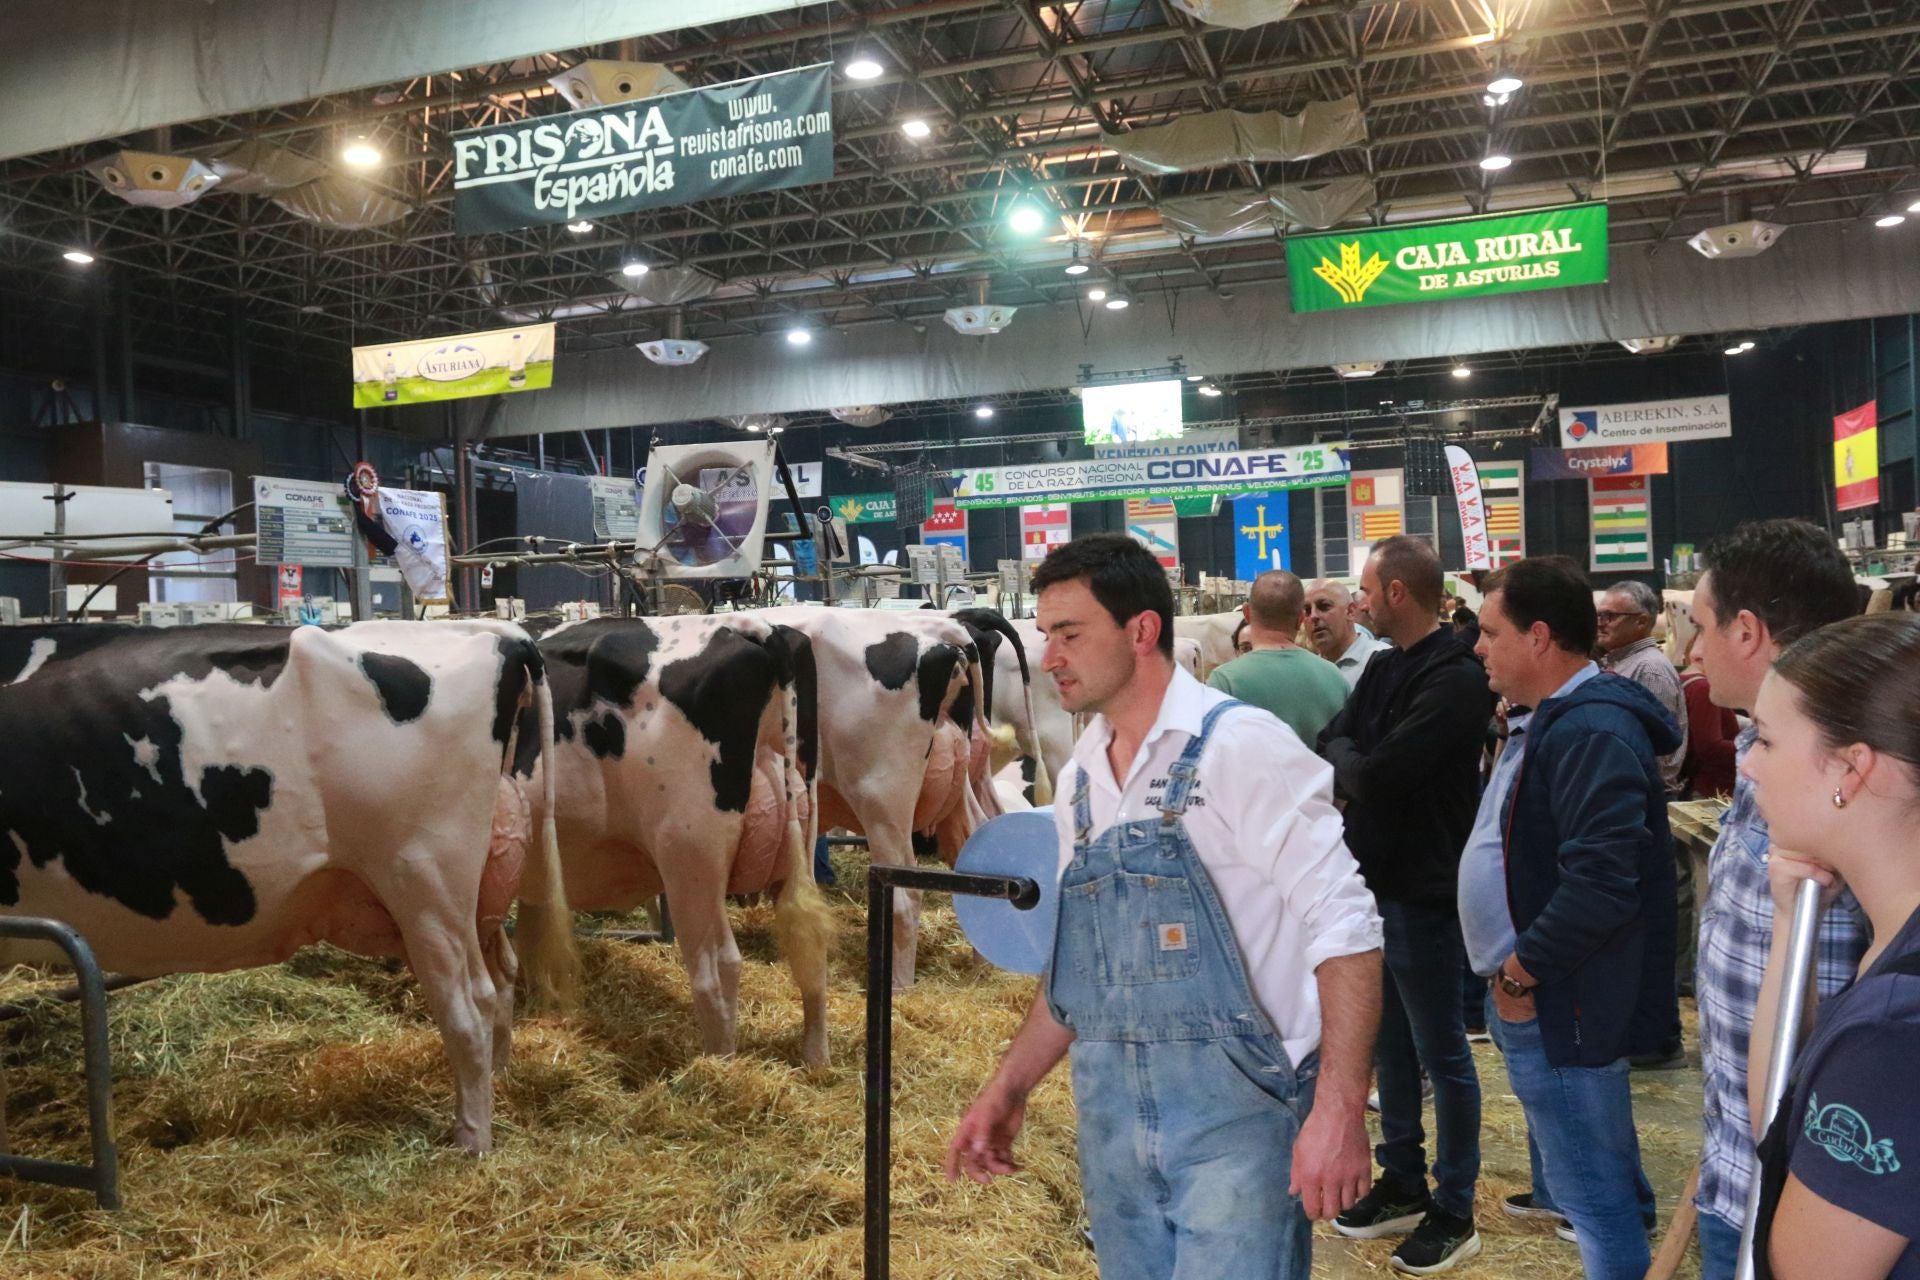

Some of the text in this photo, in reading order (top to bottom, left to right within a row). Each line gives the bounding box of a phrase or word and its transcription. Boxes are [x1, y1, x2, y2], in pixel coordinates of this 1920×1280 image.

[728, 93, 778, 121] www.
[454, 106, 674, 180] FRISONA
[680, 109, 831, 157] revistafrisona.com
[710, 145, 803, 180] conafe.com
[534, 151, 675, 219] Española
[1396, 228, 1582, 270] CAJA RURAL
[1419, 261, 1561, 291] DE ASTURIAS
[423, 358, 481, 375] ASTURIANA
[1602, 421, 1727, 438] Centro de Inseminación
[1005, 466, 1076, 481] CONCURSO
[1079, 462, 1144, 475] NACIONAL
[1147, 454, 1288, 480] CONAFE
[1568, 455, 1628, 471] Crystalyx
[1006, 494, 1044, 504] BENVIDOS
[1048, 490, 1096, 501] BENVINGUTS
[1150, 485, 1193, 494] BENVENUTI
[1197, 482, 1243, 492] BIENVENUS
[1247, 480, 1288, 489] WELCOME
[1009, 473, 1144, 491] DE LA RAZA FRISONA
[285, 493, 325, 502] CONAFE
[866, 500, 890, 511] CAJA
[386, 507, 438, 521] CONAFE 2025
